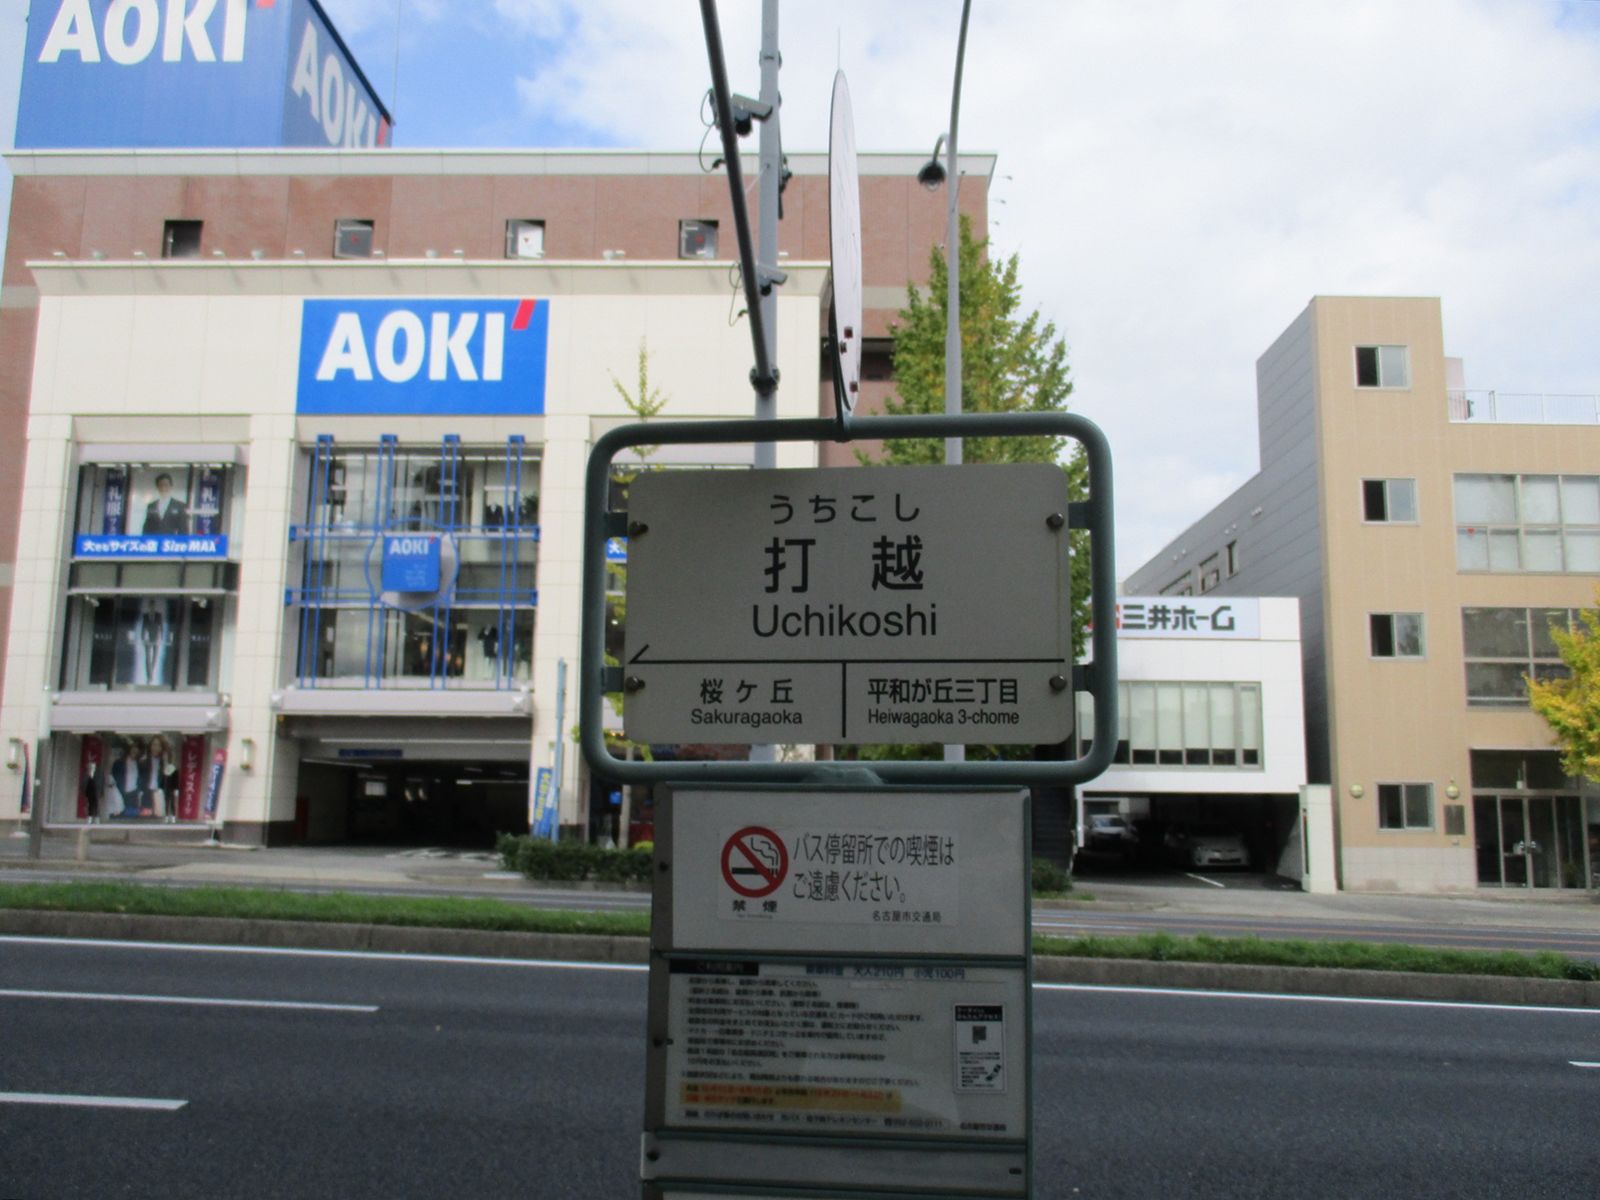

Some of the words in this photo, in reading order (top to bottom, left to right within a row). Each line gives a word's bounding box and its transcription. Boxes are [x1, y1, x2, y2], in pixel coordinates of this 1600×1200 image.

[39, 0, 247, 64] AOKI
[315, 309, 505, 383] AOKI
[769, 493, 920, 525] うちこし
[388, 538, 430, 555] AOKI
[763, 534, 924, 594] 打越
[752, 603, 937, 637] Uchikoshi
[1121, 604, 1235, 631] 三井ホーム
[867, 677, 1019, 705] 平和が丘三丁目
[690, 708, 803, 728] Sakuragaoka
[867, 707, 954, 727] Heiwagaoka
[957, 708, 1020, 725] 3-chome
[793, 833, 954, 866] バス停留所での喫煙は
[793, 870, 907, 904] ご遠慮ください。
[872, 910, 942, 923] 名古屋市交通局
